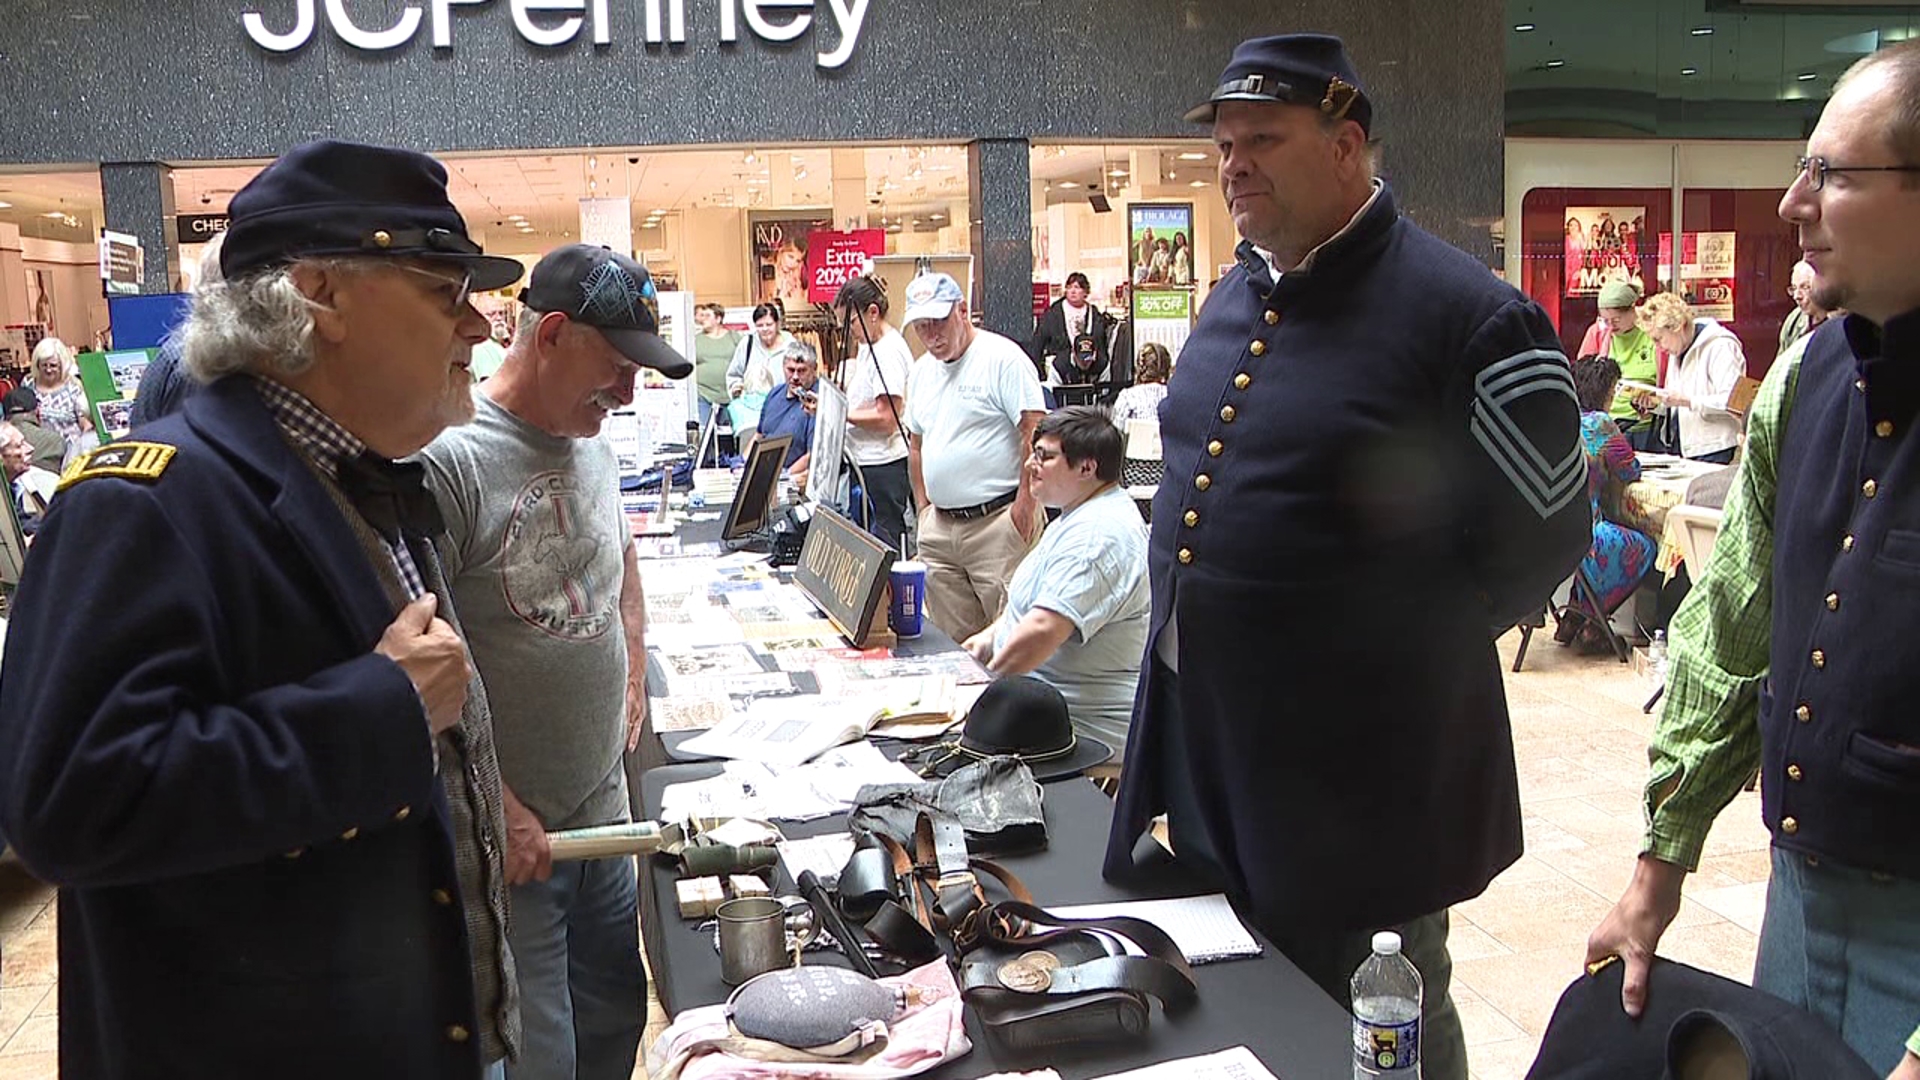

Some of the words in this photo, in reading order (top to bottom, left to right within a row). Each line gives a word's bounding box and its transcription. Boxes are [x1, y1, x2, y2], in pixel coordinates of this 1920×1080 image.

[191, 218, 231, 232] CHEC
[825, 248, 866, 266] Extra
[815, 266, 847, 286] 20%
